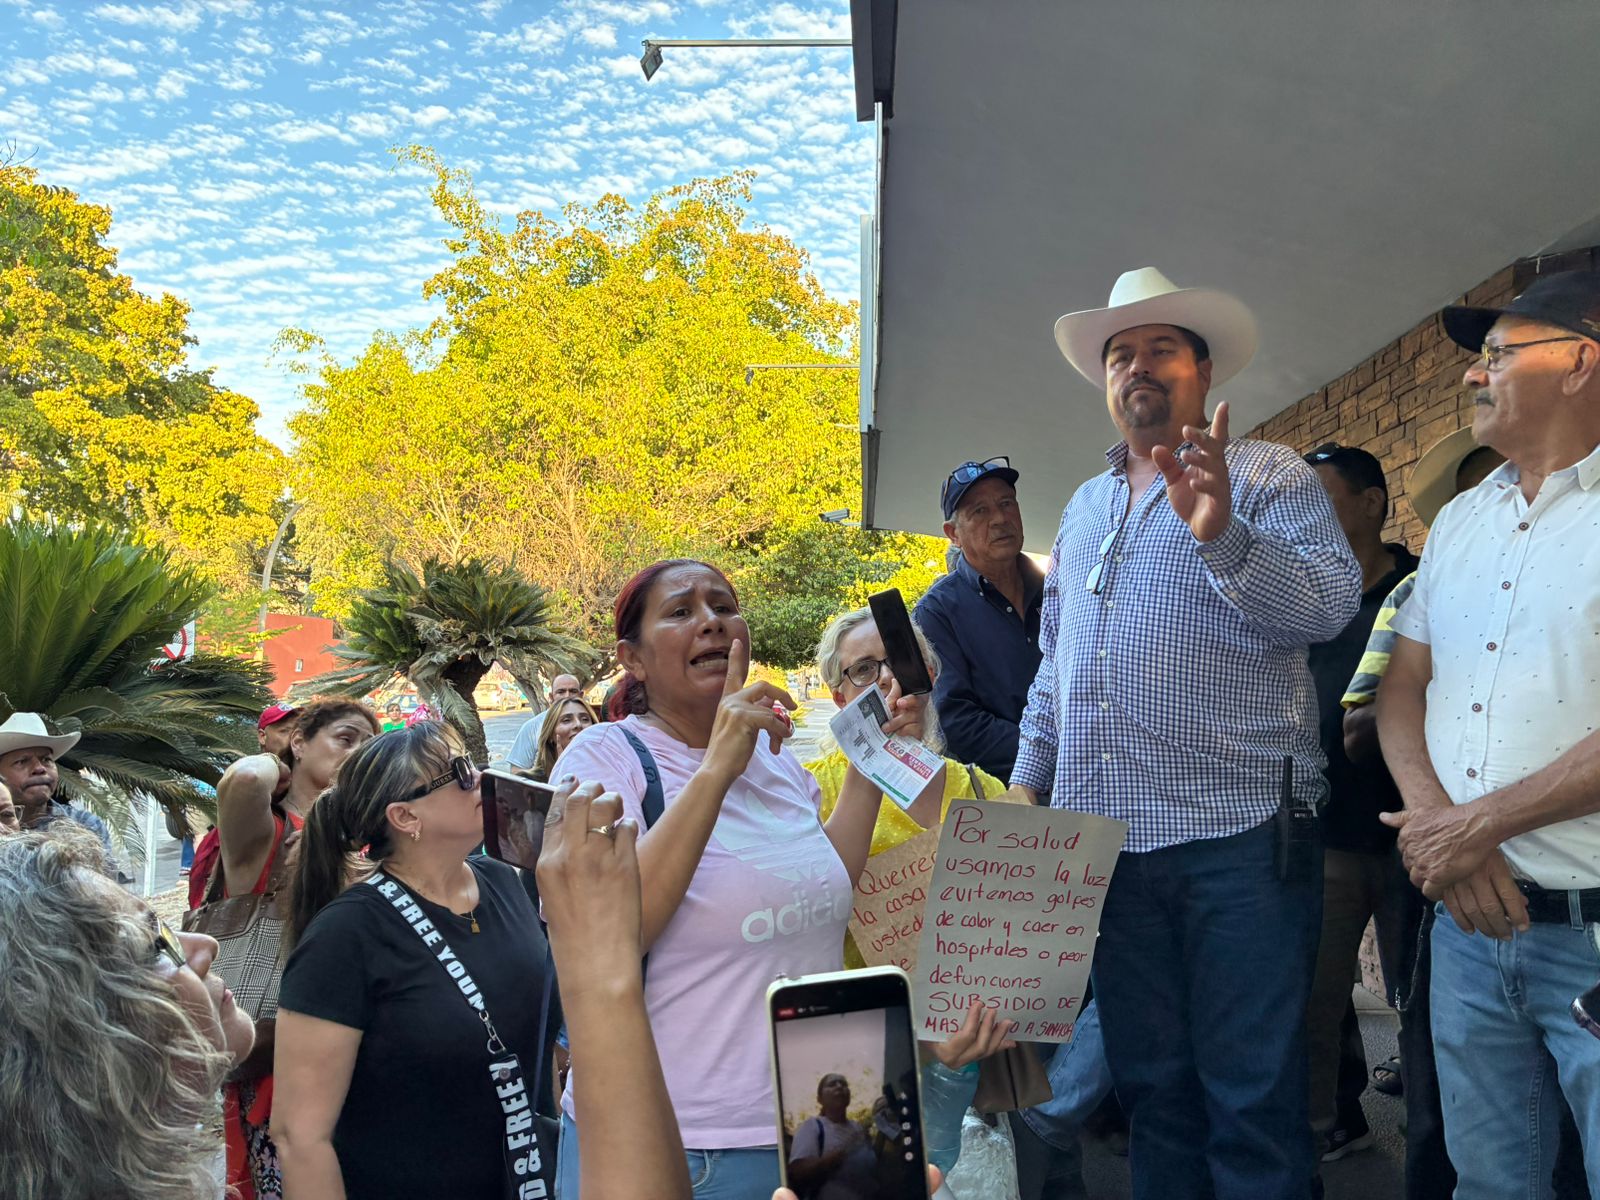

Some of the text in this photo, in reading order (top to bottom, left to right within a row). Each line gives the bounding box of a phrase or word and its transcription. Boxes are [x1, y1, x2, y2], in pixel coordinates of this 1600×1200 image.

[952, 806, 1081, 850] Por salud
[946, 856, 1108, 887] usamos la luz
[853, 887, 927, 927] la casa
[940, 883, 1096, 914] evitemos golpes
[391, 893, 442, 947] FREE
[871, 915, 925, 953] usted
[936, 910, 955, 928] de
[1003, 922, 1011, 937] y
[1022, 918, 1059, 935] caer
[1065, 925, 1085, 937] en
[936, 933, 1088, 968] hospitales o peor
[929, 964, 1042, 990] defunciones
[928, 991, 1079, 1013] SUBSIDIO DE
[925, 1016, 959, 1034] MAS
[495, 1075, 538, 1151] FREE
[513, 1147, 542, 1175] &
